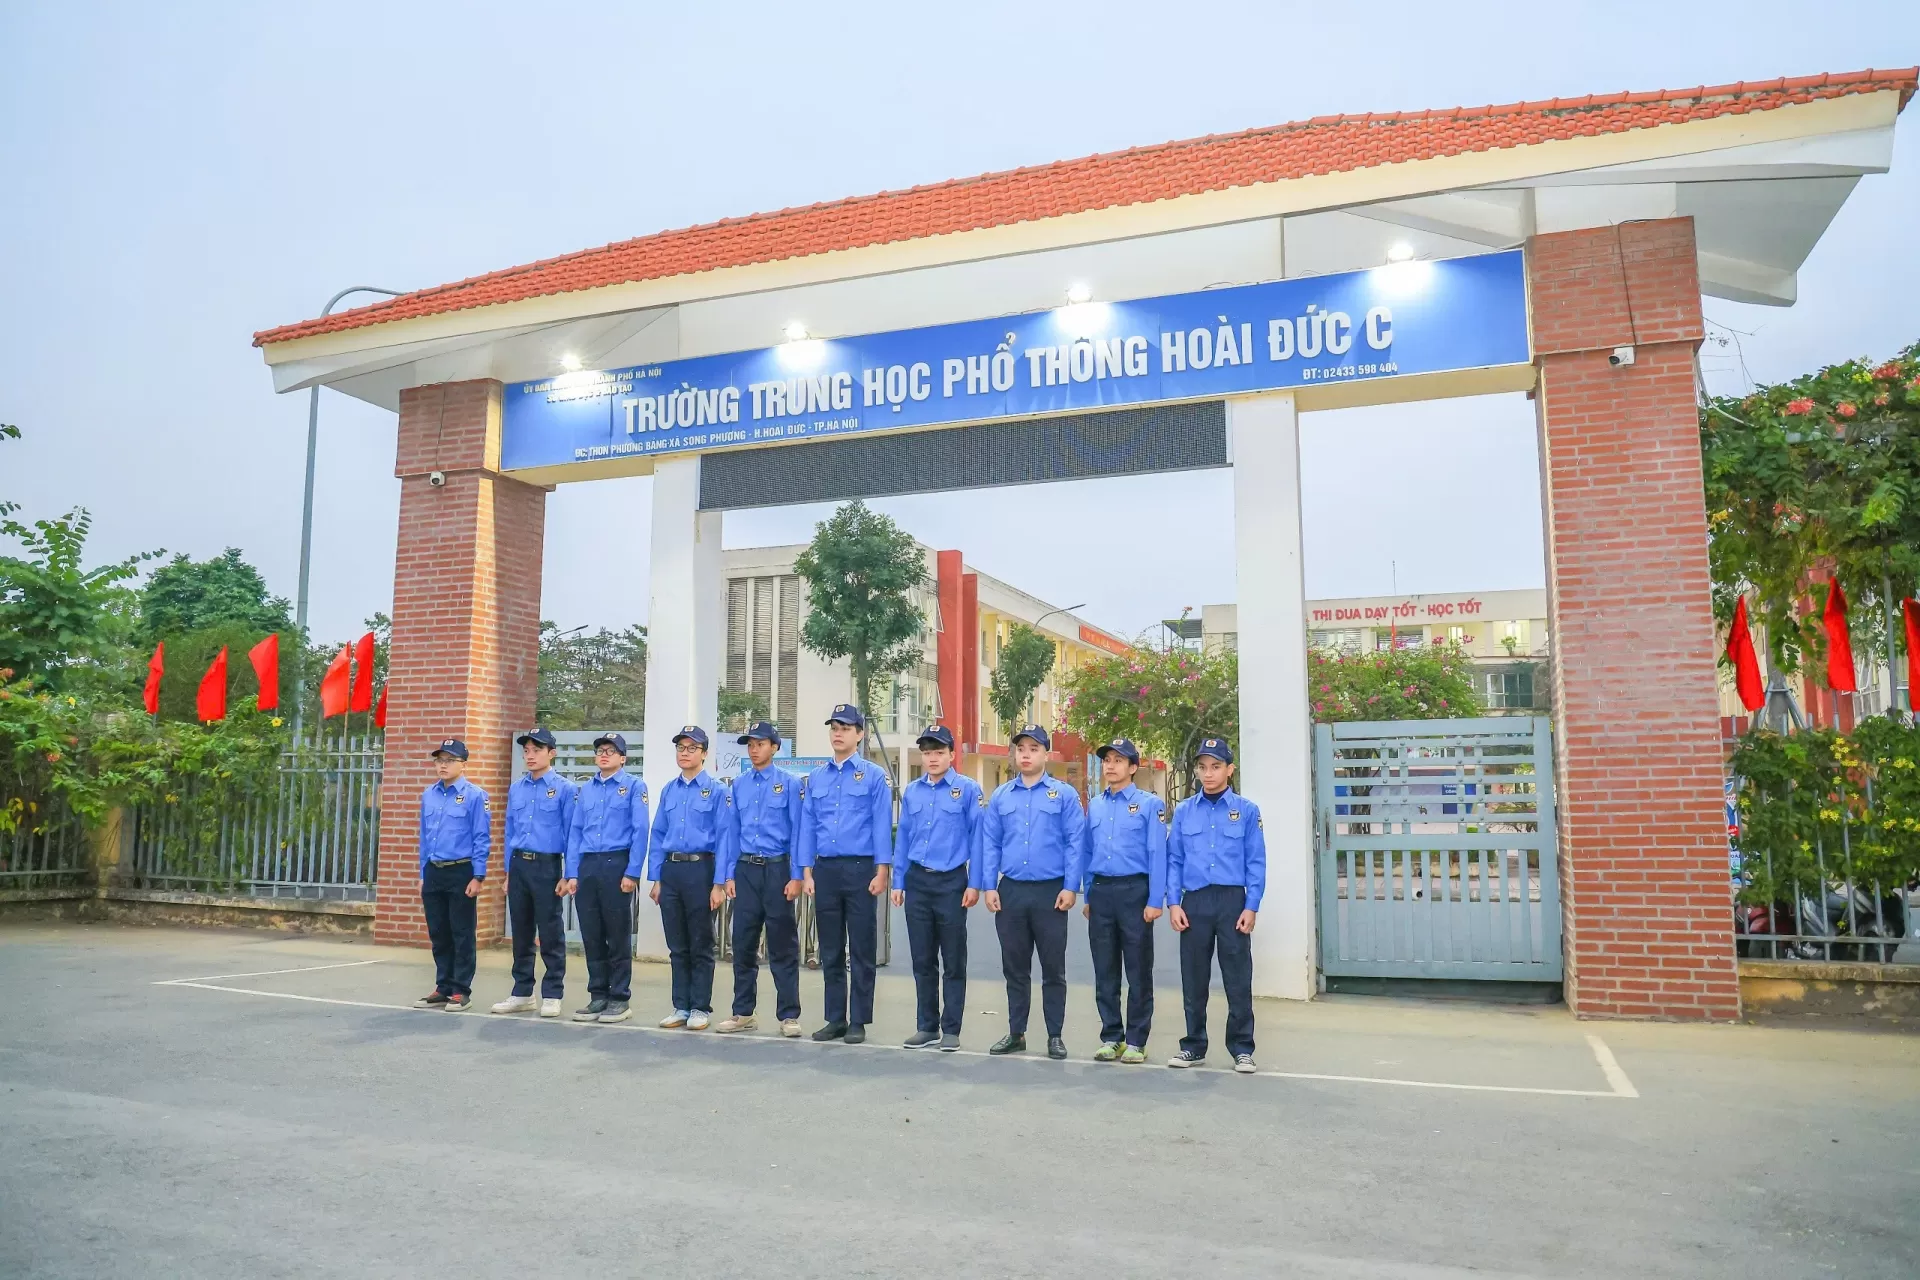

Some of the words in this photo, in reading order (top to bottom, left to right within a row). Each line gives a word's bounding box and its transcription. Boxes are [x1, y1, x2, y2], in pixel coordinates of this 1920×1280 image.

[592, 373, 616, 385] HÀNH
[617, 368, 634, 381] PHỐ
[635, 369, 646, 379] HÀ
[648, 368, 662, 380] NỘI
[622, 381, 740, 434] TRƯỜNG
[748, 371, 852, 420] TRUNG
[863, 362, 931, 413] HỌC
[943, 331, 1017, 398] PHỔ
[1024, 335, 1149, 389] THÔNG
[1161, 315, 1253, 373] HOÀI
[1267, 304, 1352, 361] ĐỨC
[1365, 306, 1393, 350] C
[1303, 367, 1321, 380] ĐT:
[1323, 365, 1355, 379] 02433
[1358, 363, 1377, 375] 598
[1379, 361, 1398, 373] 404
[683, 434, 707, 446] SONG
[710, 430, 746, 444] PHƯƠNG
[787, 421, 806, 435] ĐỨC
[842, 416, 858, 430] NỘI
[1335, 608, 1362, 620] ĐUA
[1392, 600, 1417, 617] TỐT
[1427, 603, 1454, 618] HỌC
[1457, 597, 1482, 614] TỐT
